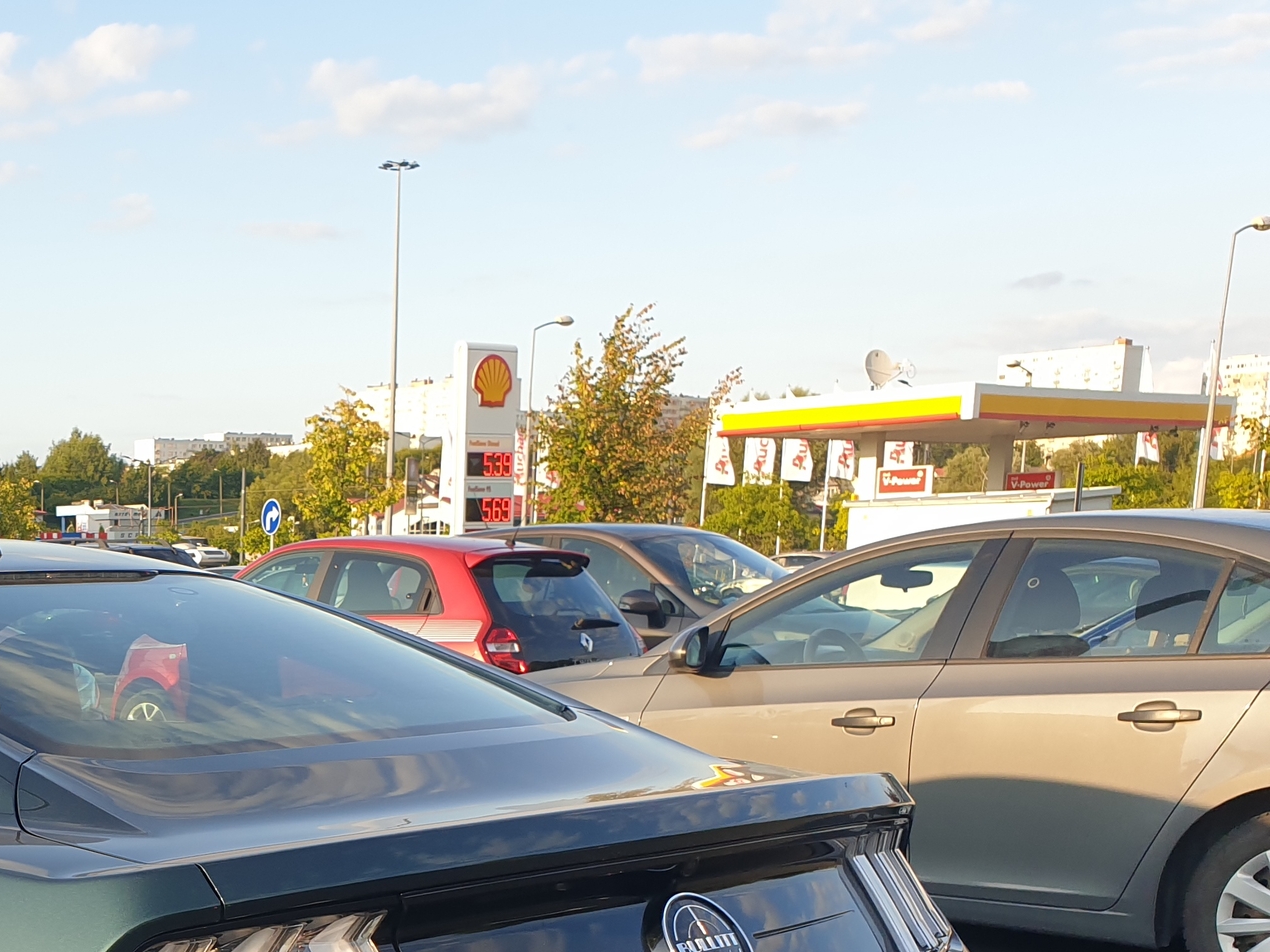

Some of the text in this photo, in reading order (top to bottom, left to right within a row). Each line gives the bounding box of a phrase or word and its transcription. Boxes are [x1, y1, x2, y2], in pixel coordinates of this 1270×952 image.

[483, 452, 512, 477] 5.39
[1011, 480, 1049, 490] V-Power
[482, 498, 511, 523] 5.69
